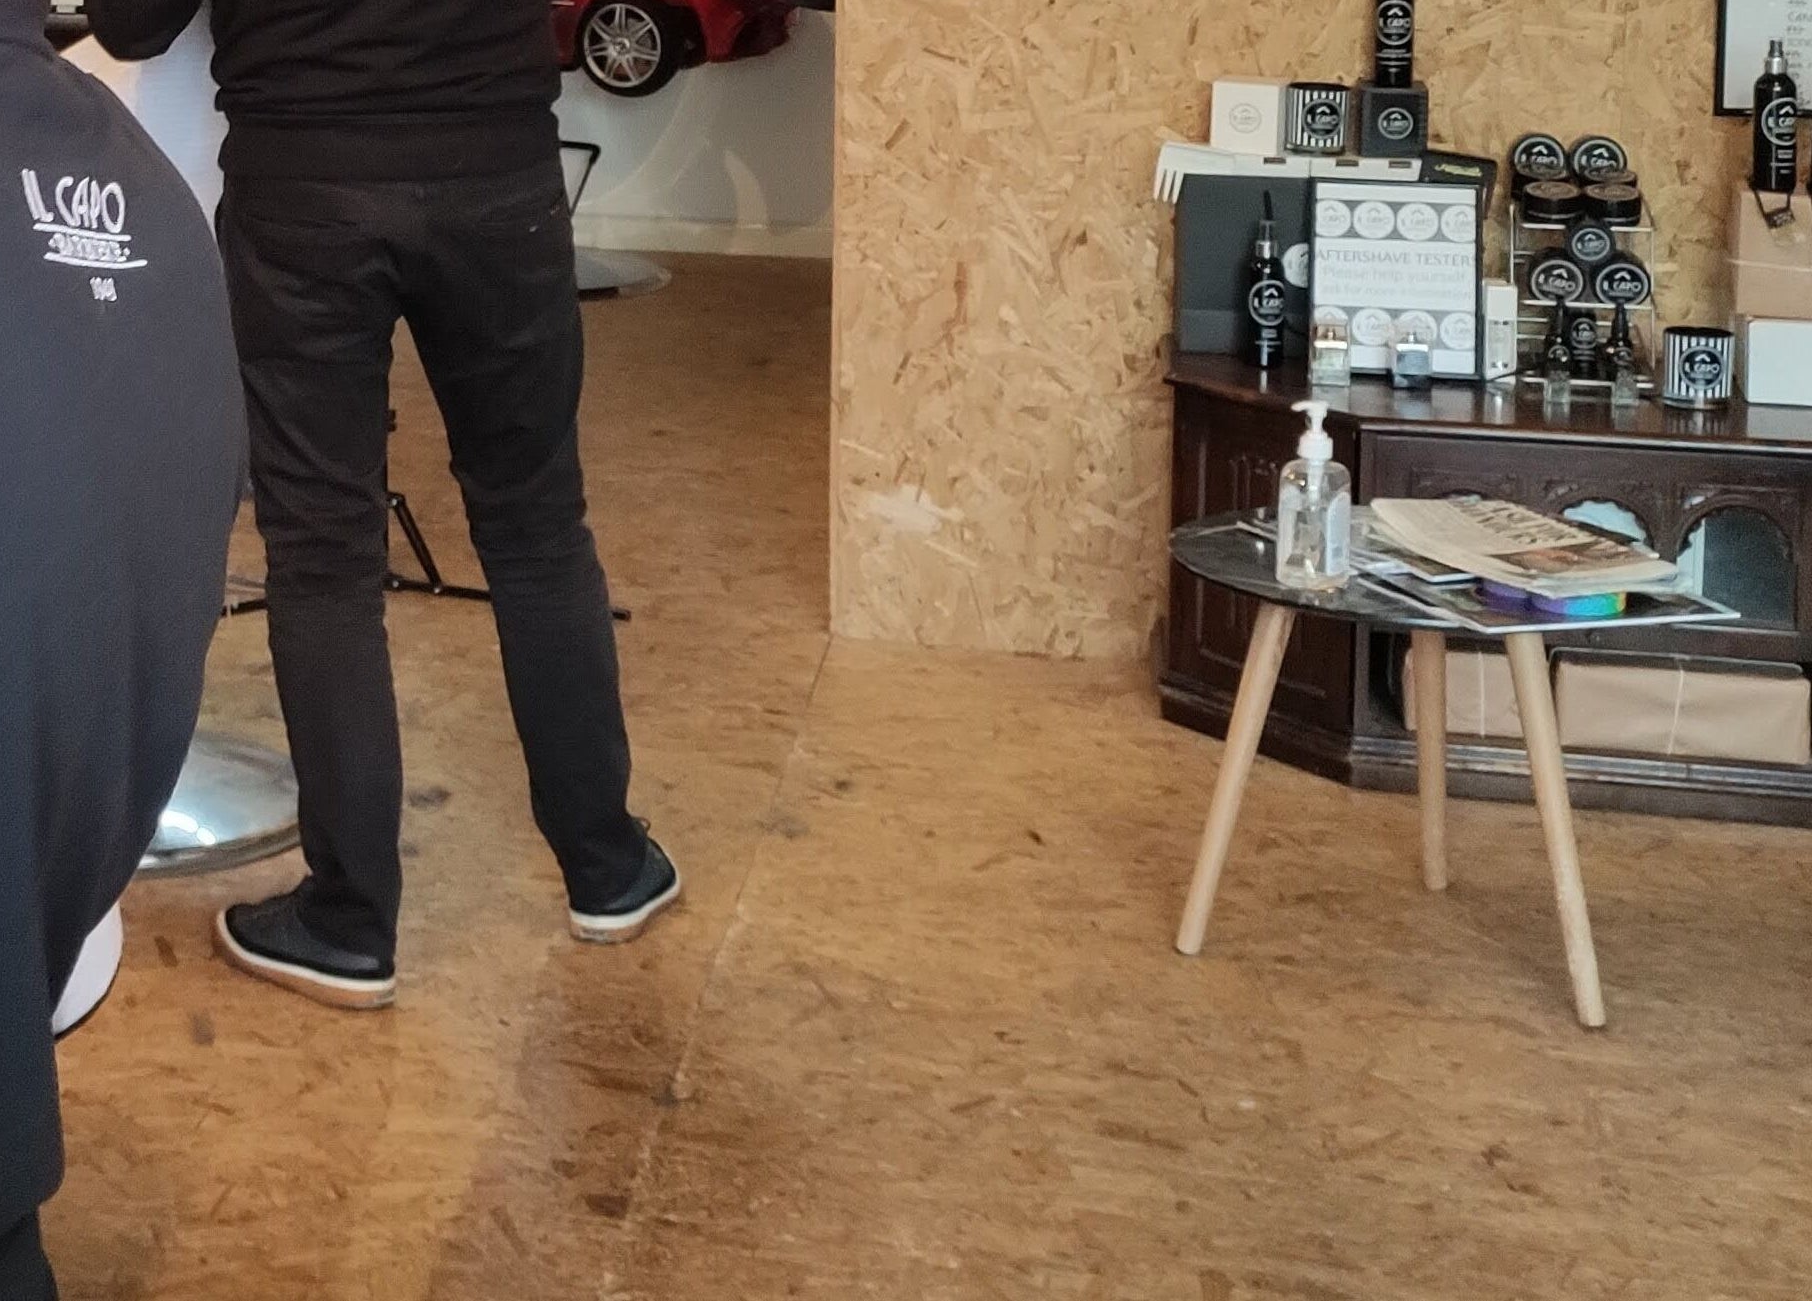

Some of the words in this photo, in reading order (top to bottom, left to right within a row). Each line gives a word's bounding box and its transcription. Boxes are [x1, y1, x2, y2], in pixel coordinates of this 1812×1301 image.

[21, 168, 54, 222] IL
[55, 176, 126, 234] CAPO
[1315, 249, 1409, 264] AFTERSHAVE
[1417, 253, 1475, 267] TESTER
